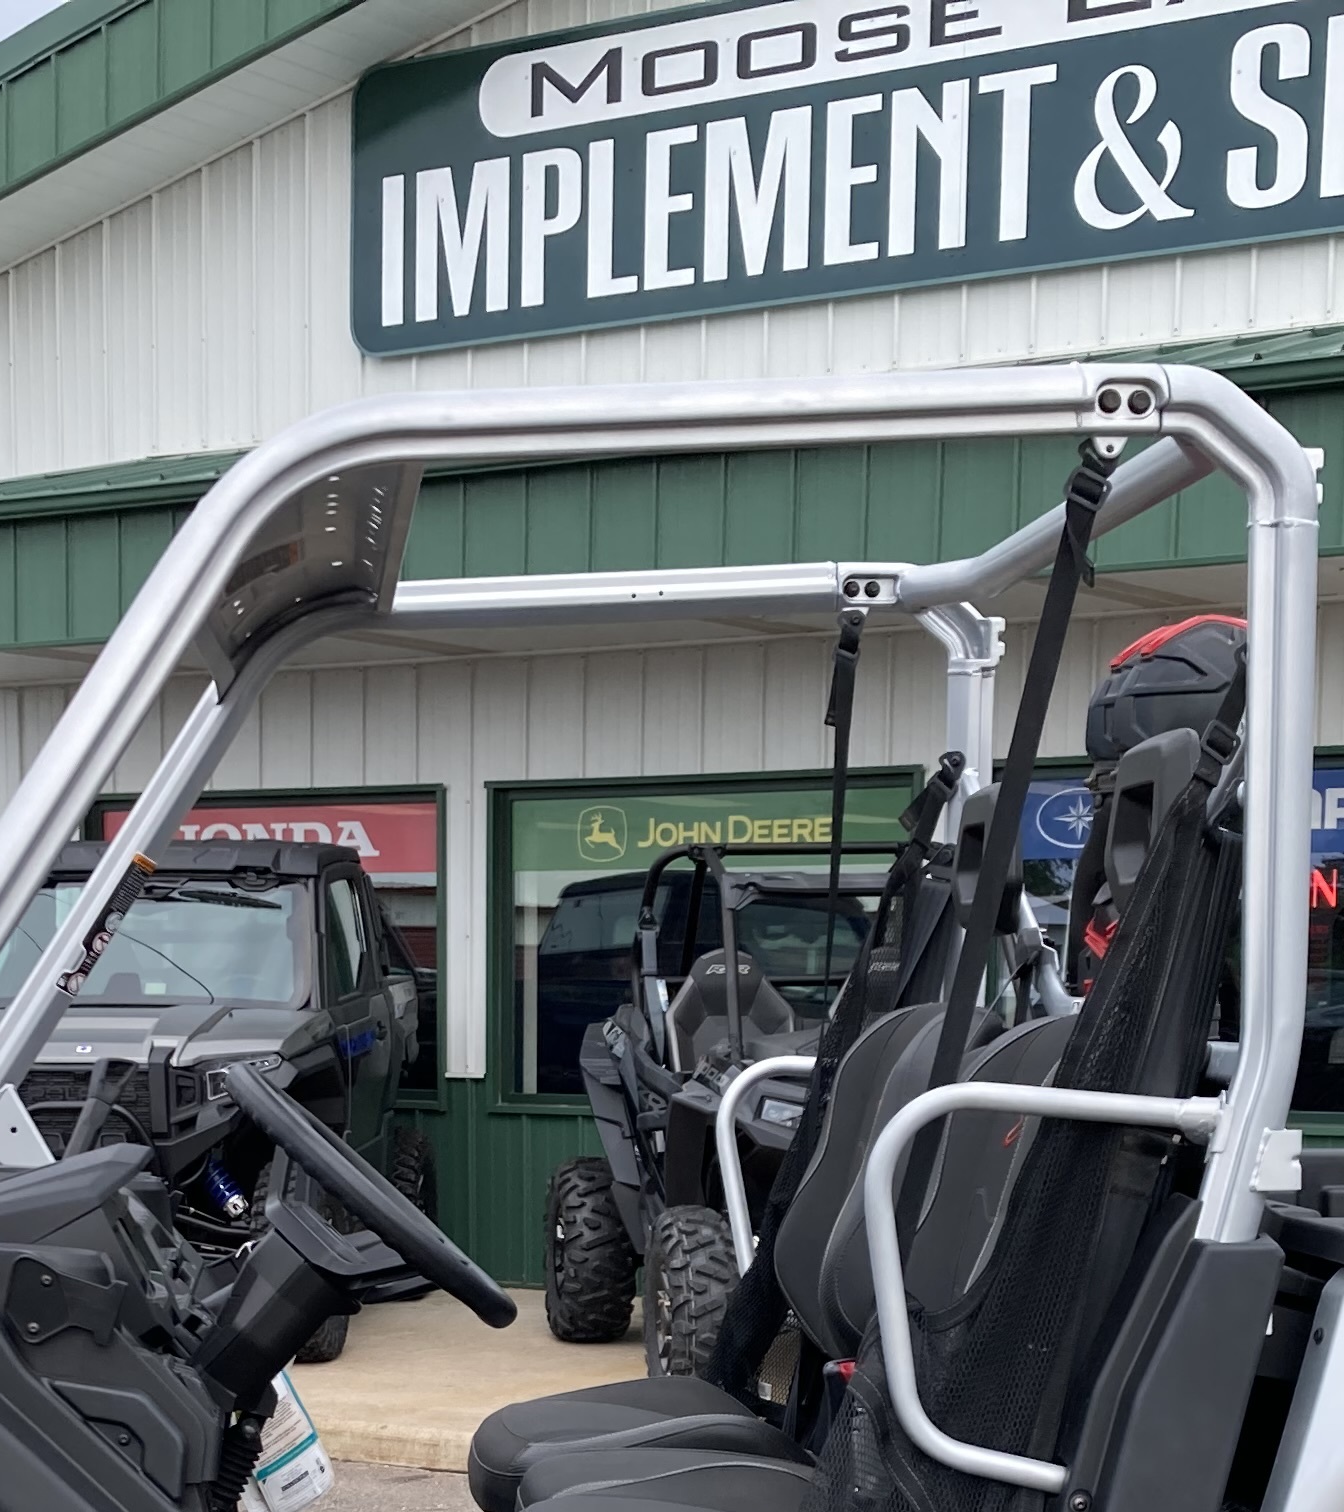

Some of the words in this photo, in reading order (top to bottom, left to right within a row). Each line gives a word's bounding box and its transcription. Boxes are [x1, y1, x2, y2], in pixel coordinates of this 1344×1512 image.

[530, 0, 1003, 118] MOOSE
[379, 64, 1057, 327] IMPLEMENT
[1074, 64, 1196, 230] &
[637, 817, 722, 848] JOHN
[727, 815, 833, 844] DEERE
